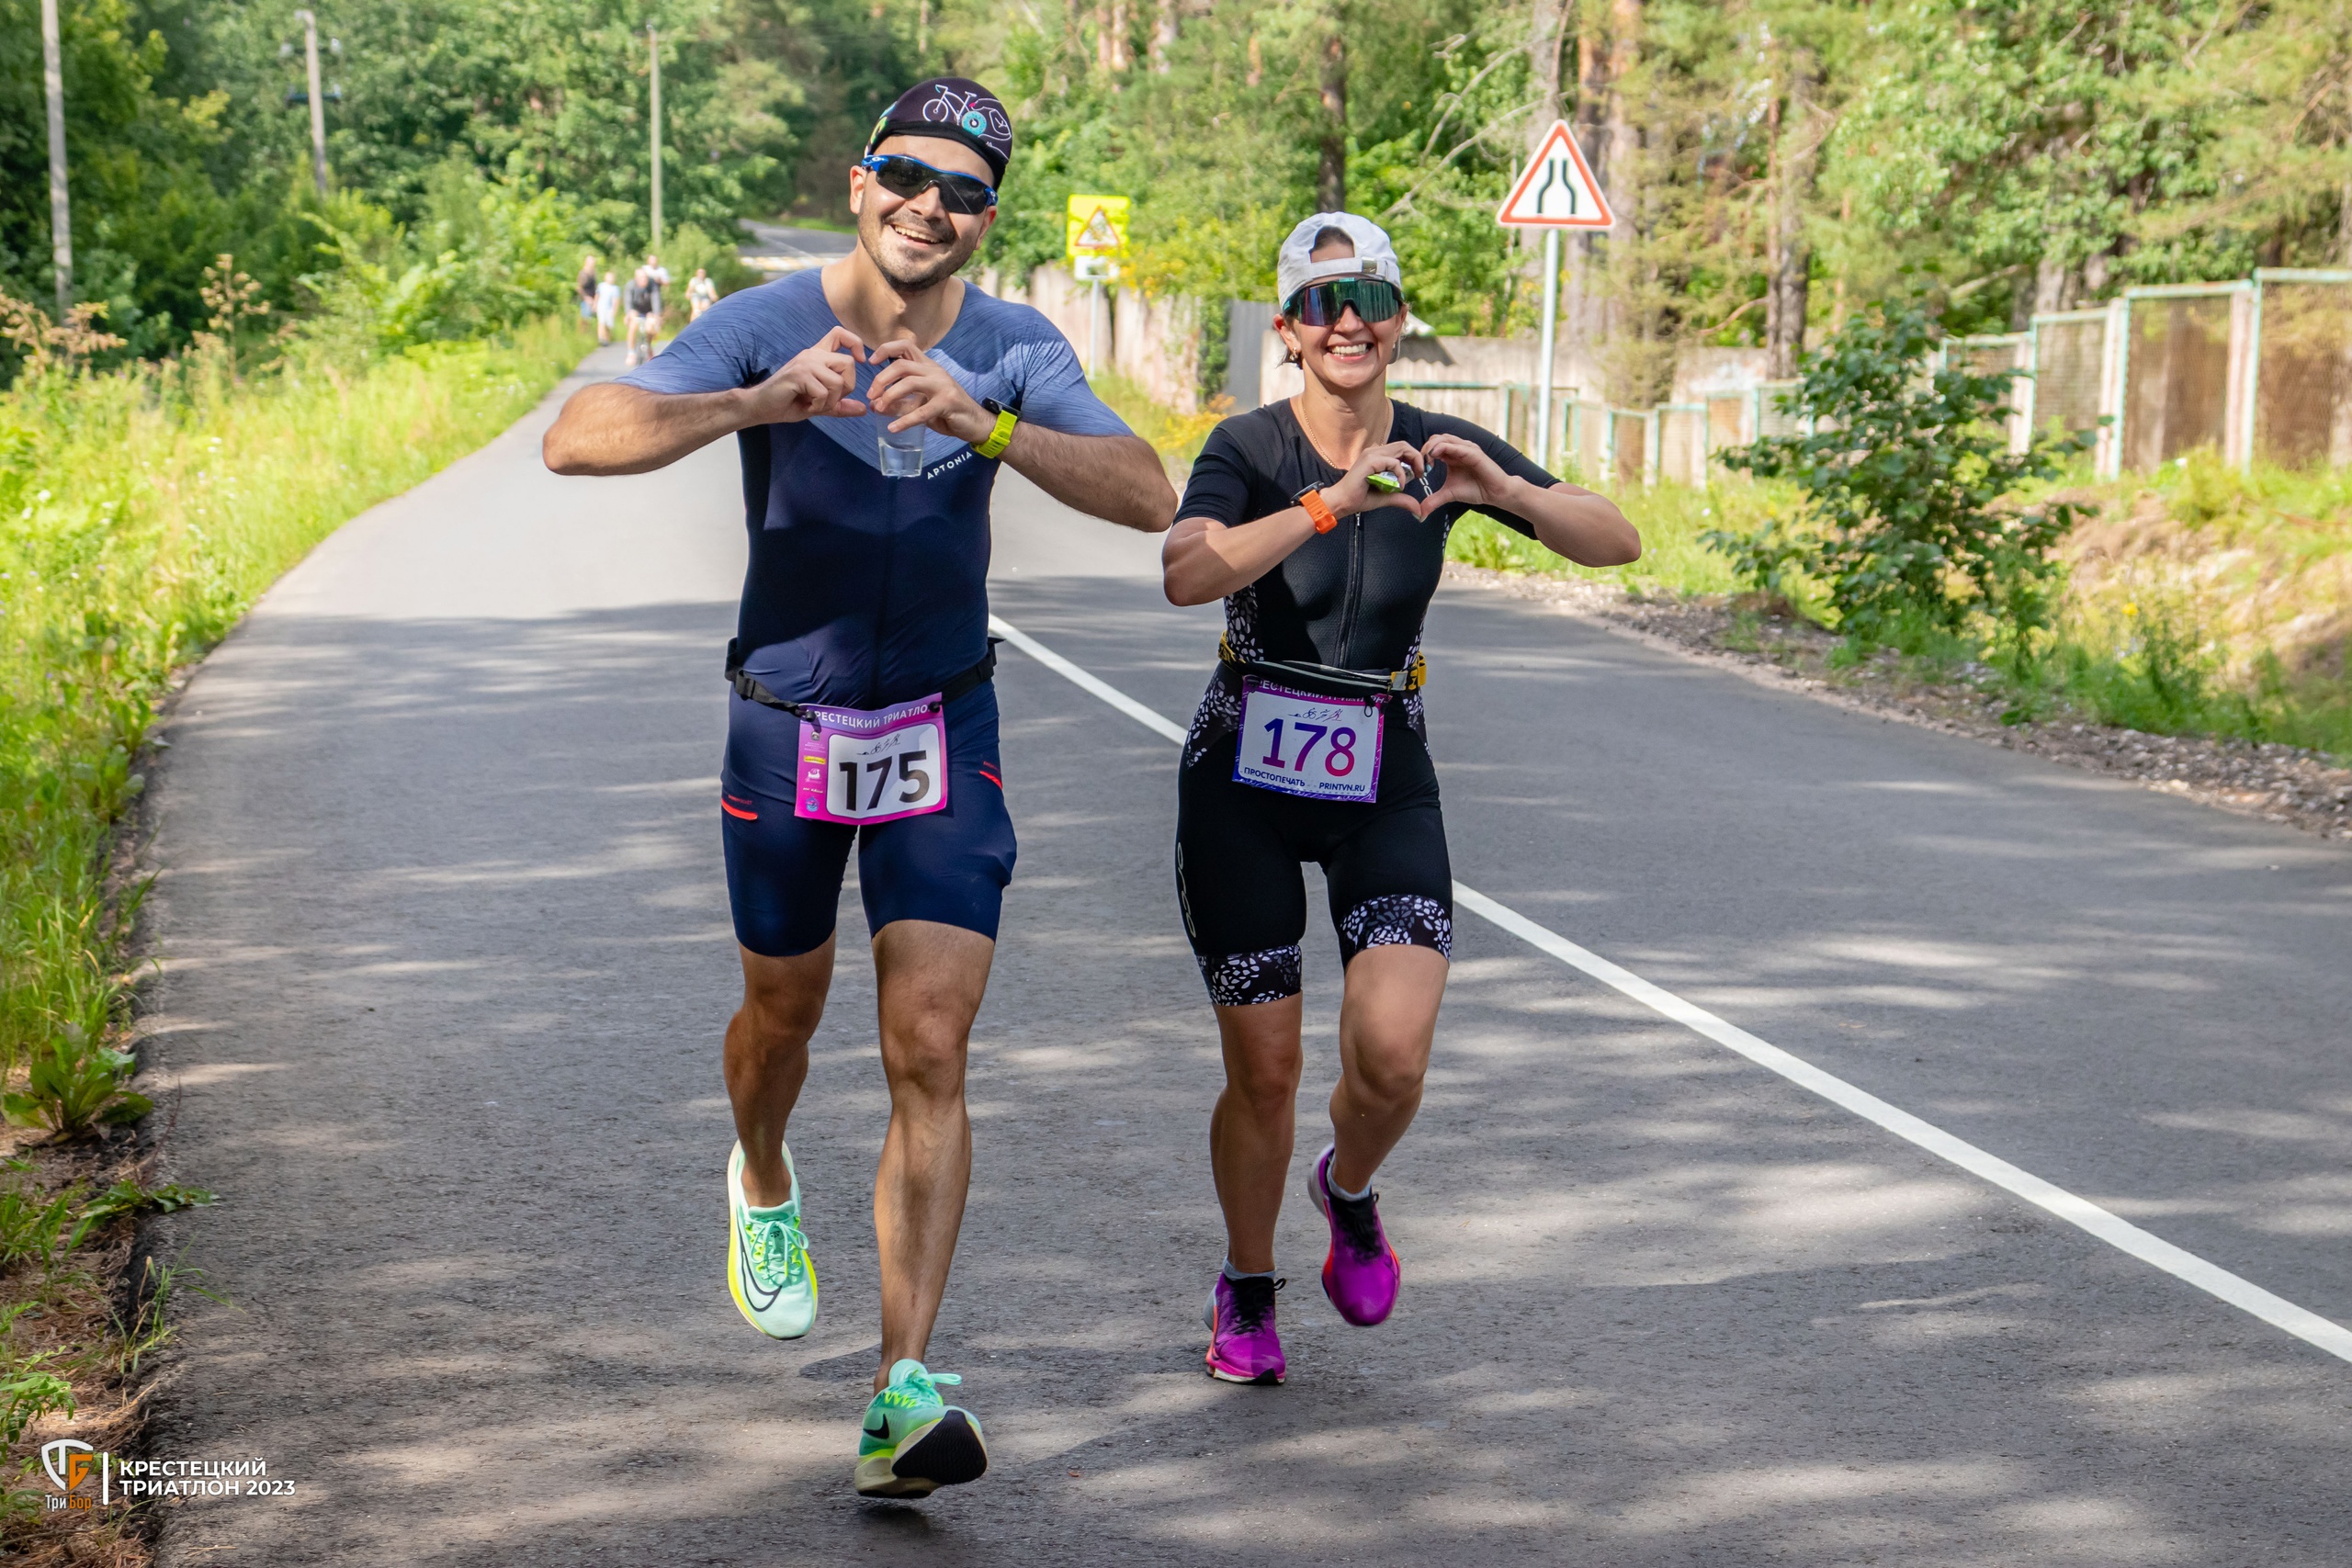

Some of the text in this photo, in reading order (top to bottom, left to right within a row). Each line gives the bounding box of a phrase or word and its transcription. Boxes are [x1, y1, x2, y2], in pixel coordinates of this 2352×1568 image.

[927, 451, 972, 479] APTONIA
[806, 704, 931, 728] РЕСТЕЦКИЙ ТРИАТЛО
[1262, 718, 1356, 777] 178
[838, 750, 930, 811] 175
[1244, 767, 1306, 787] ПРОСТОПЕЧАТЬ
[1318, 782, 1365, 792] PRINTVN.RU
